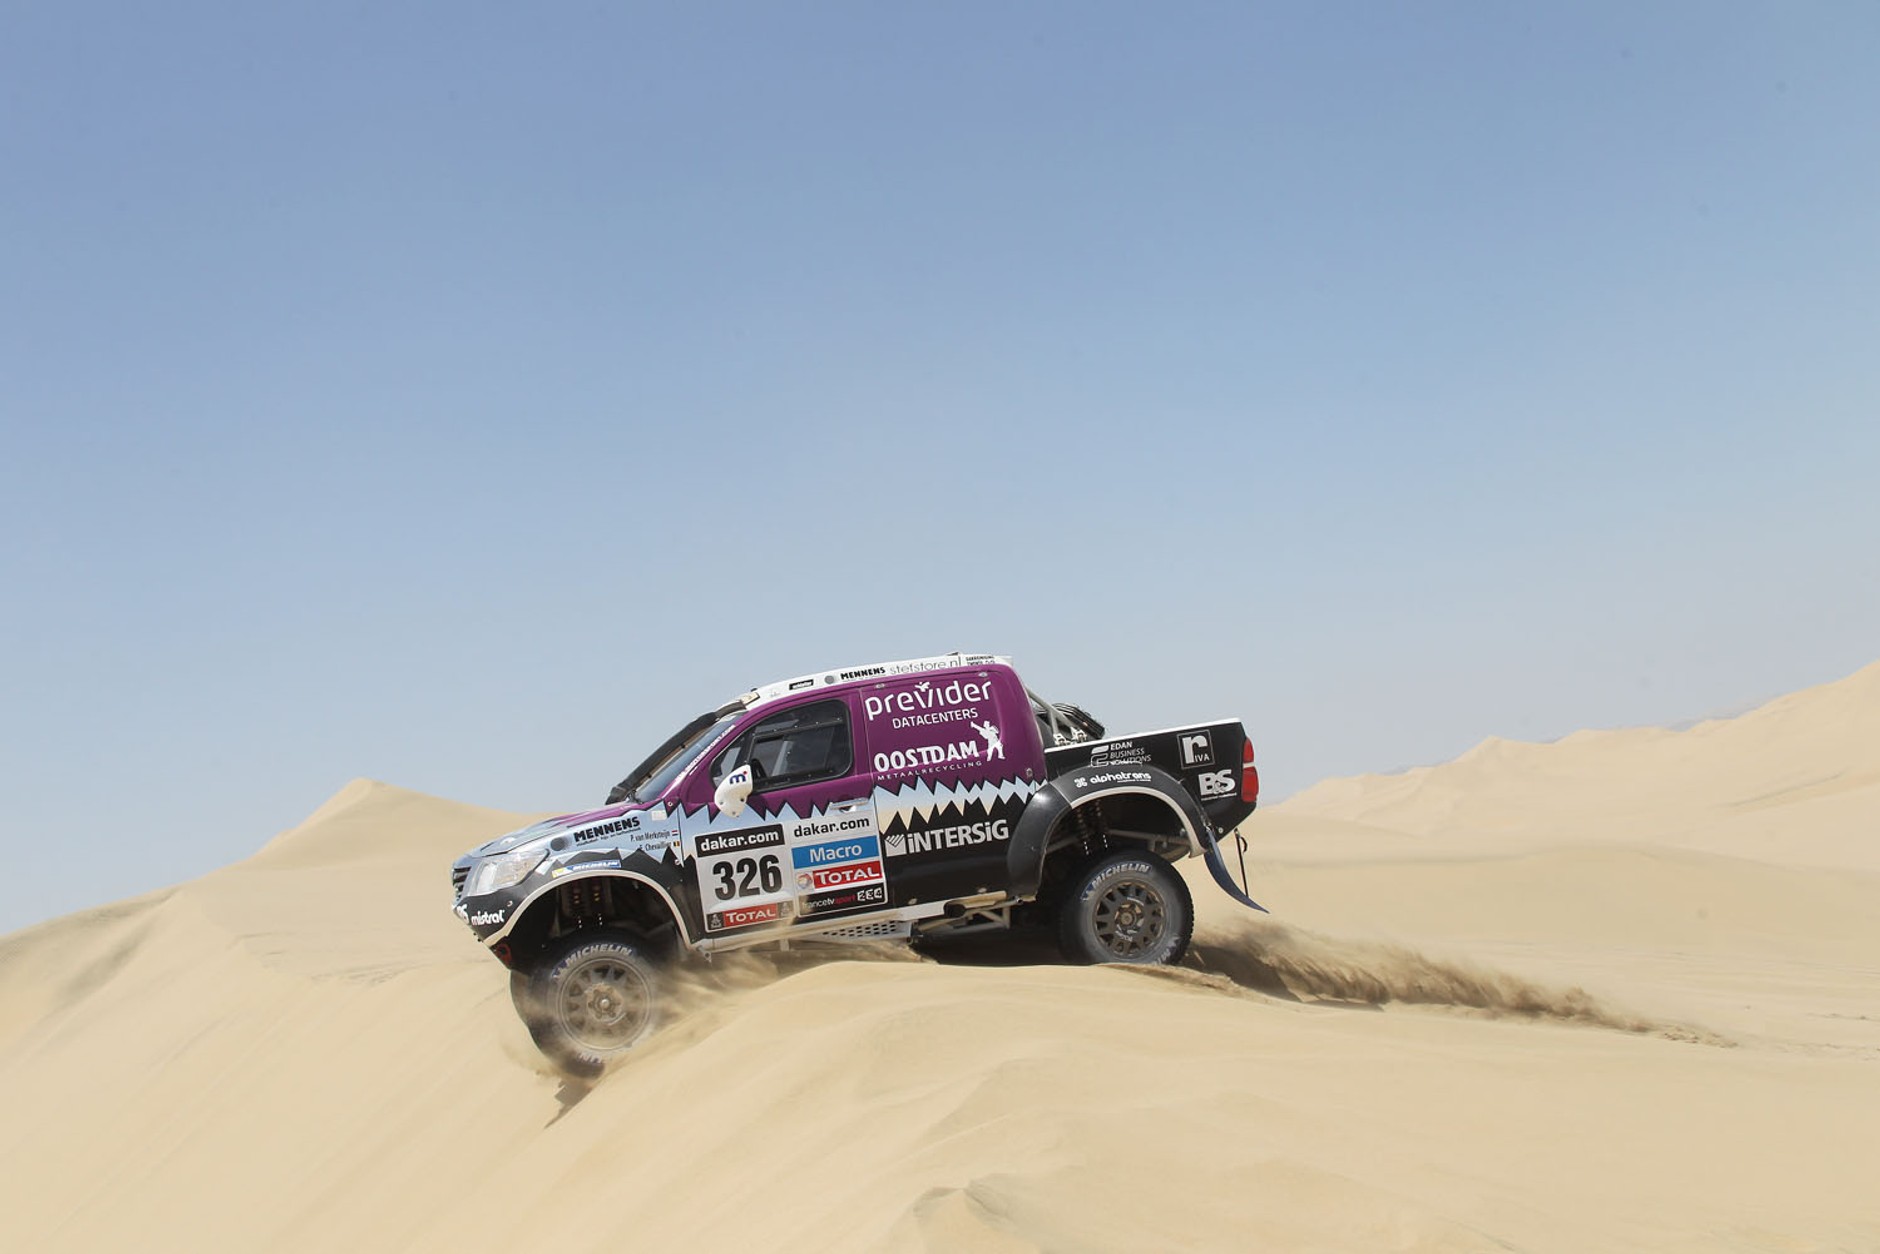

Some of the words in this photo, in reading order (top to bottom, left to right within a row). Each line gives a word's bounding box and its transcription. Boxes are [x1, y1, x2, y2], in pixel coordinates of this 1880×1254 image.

[840, 666, 886, 680] MENNENS
[889, 655, 962, 675] stefstore.nl
[865, 680, 991, 721] previder
[892, 707, 979, 729] DATACENTERS
[873, 740, 980, 773] OOSTDAM
[1110, 741, 1133, 751] EDAN
[1110, 747, 1145, 759] BUSINESS
[877, 760, 982, 781] METAALRECYCLING
[1090, 771, 1151, 784] alphatrans
[573, 816, 641, 842] MENNENS
[794, 817, 870, 838] dakar.com
[700, 830, 780, 852] dakar.com
[809, 844, 863, 864] Macro
[712, 854, 783, 901] 326
[814, 866, 881, 887] TOTAL
[1092, 862, 1151, 889] MICHELIN
[471, 909, 505, 926] mistral
[725, 909, 777, 924] TOTAL
[565, 943, 633, 968] MICHELIN
